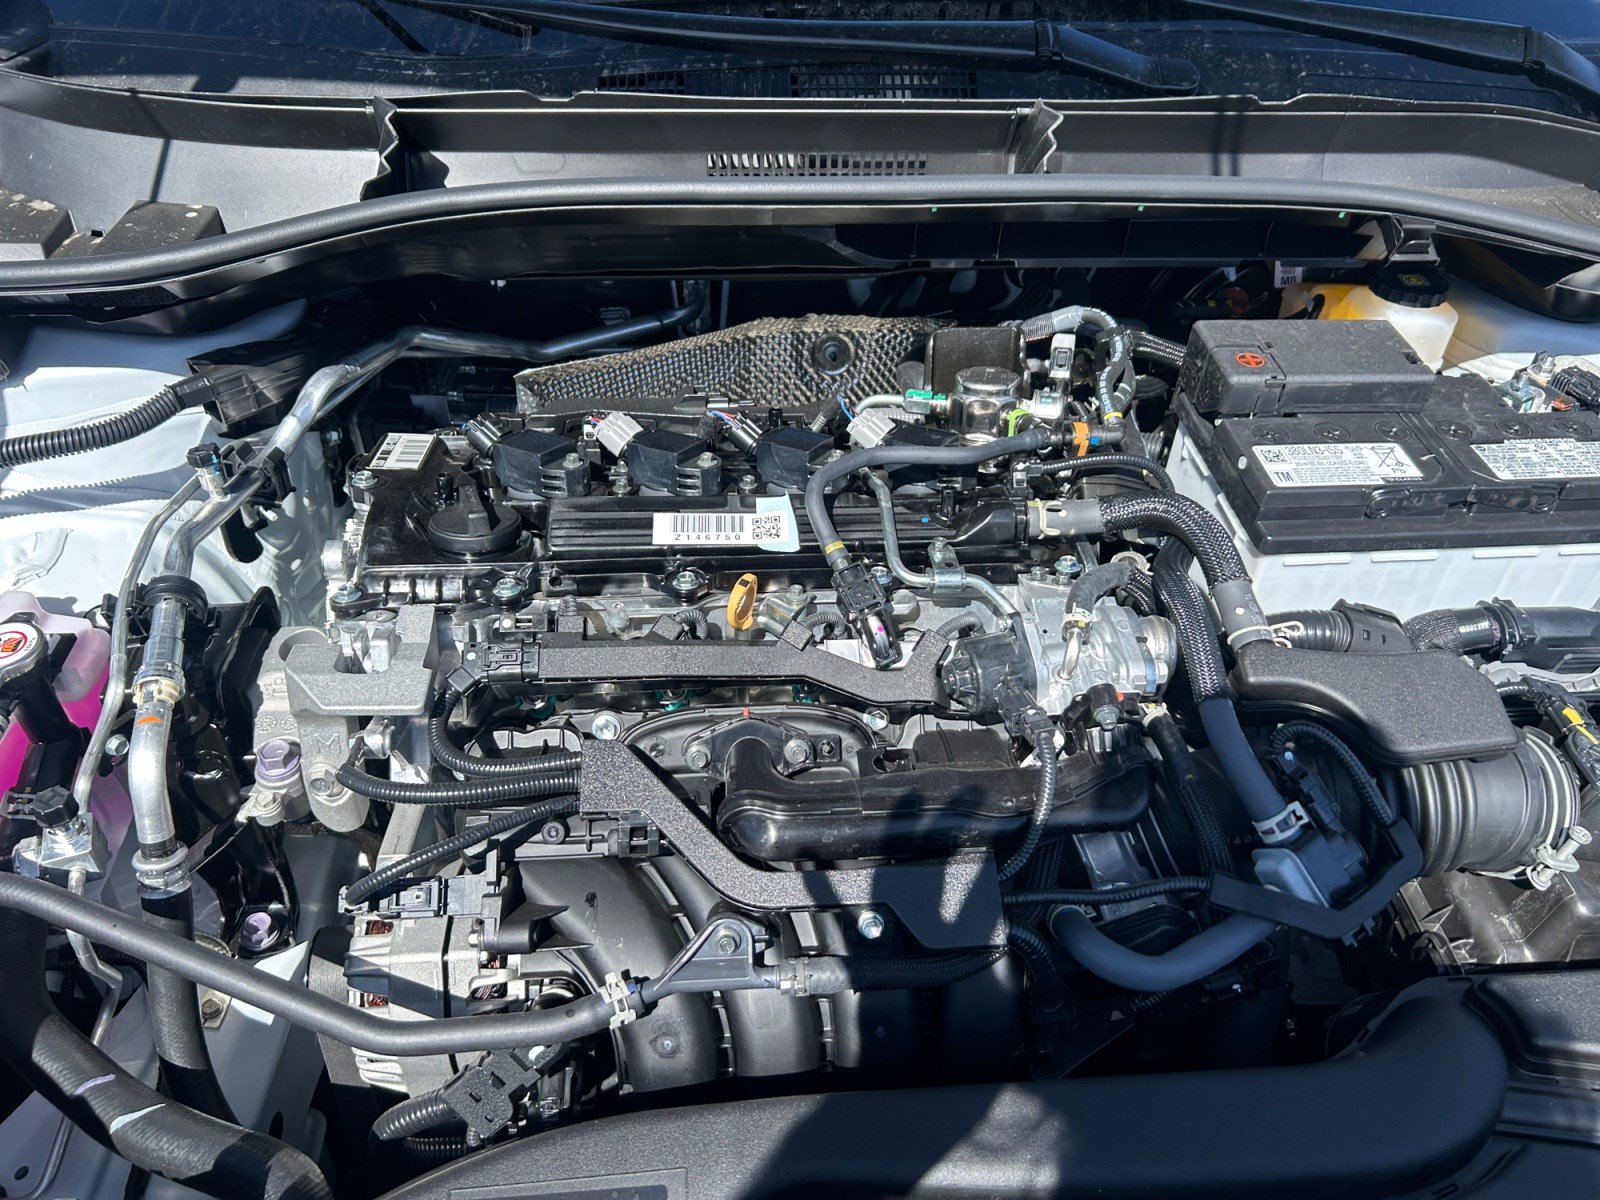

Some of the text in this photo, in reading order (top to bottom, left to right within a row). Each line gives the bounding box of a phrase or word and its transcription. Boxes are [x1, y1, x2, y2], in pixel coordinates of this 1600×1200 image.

[1280, 275, 1297, 286] M8
[1284, 445, 1343, 456] 380LN3-ISS
[1273, 471, 1294, 482] TM
